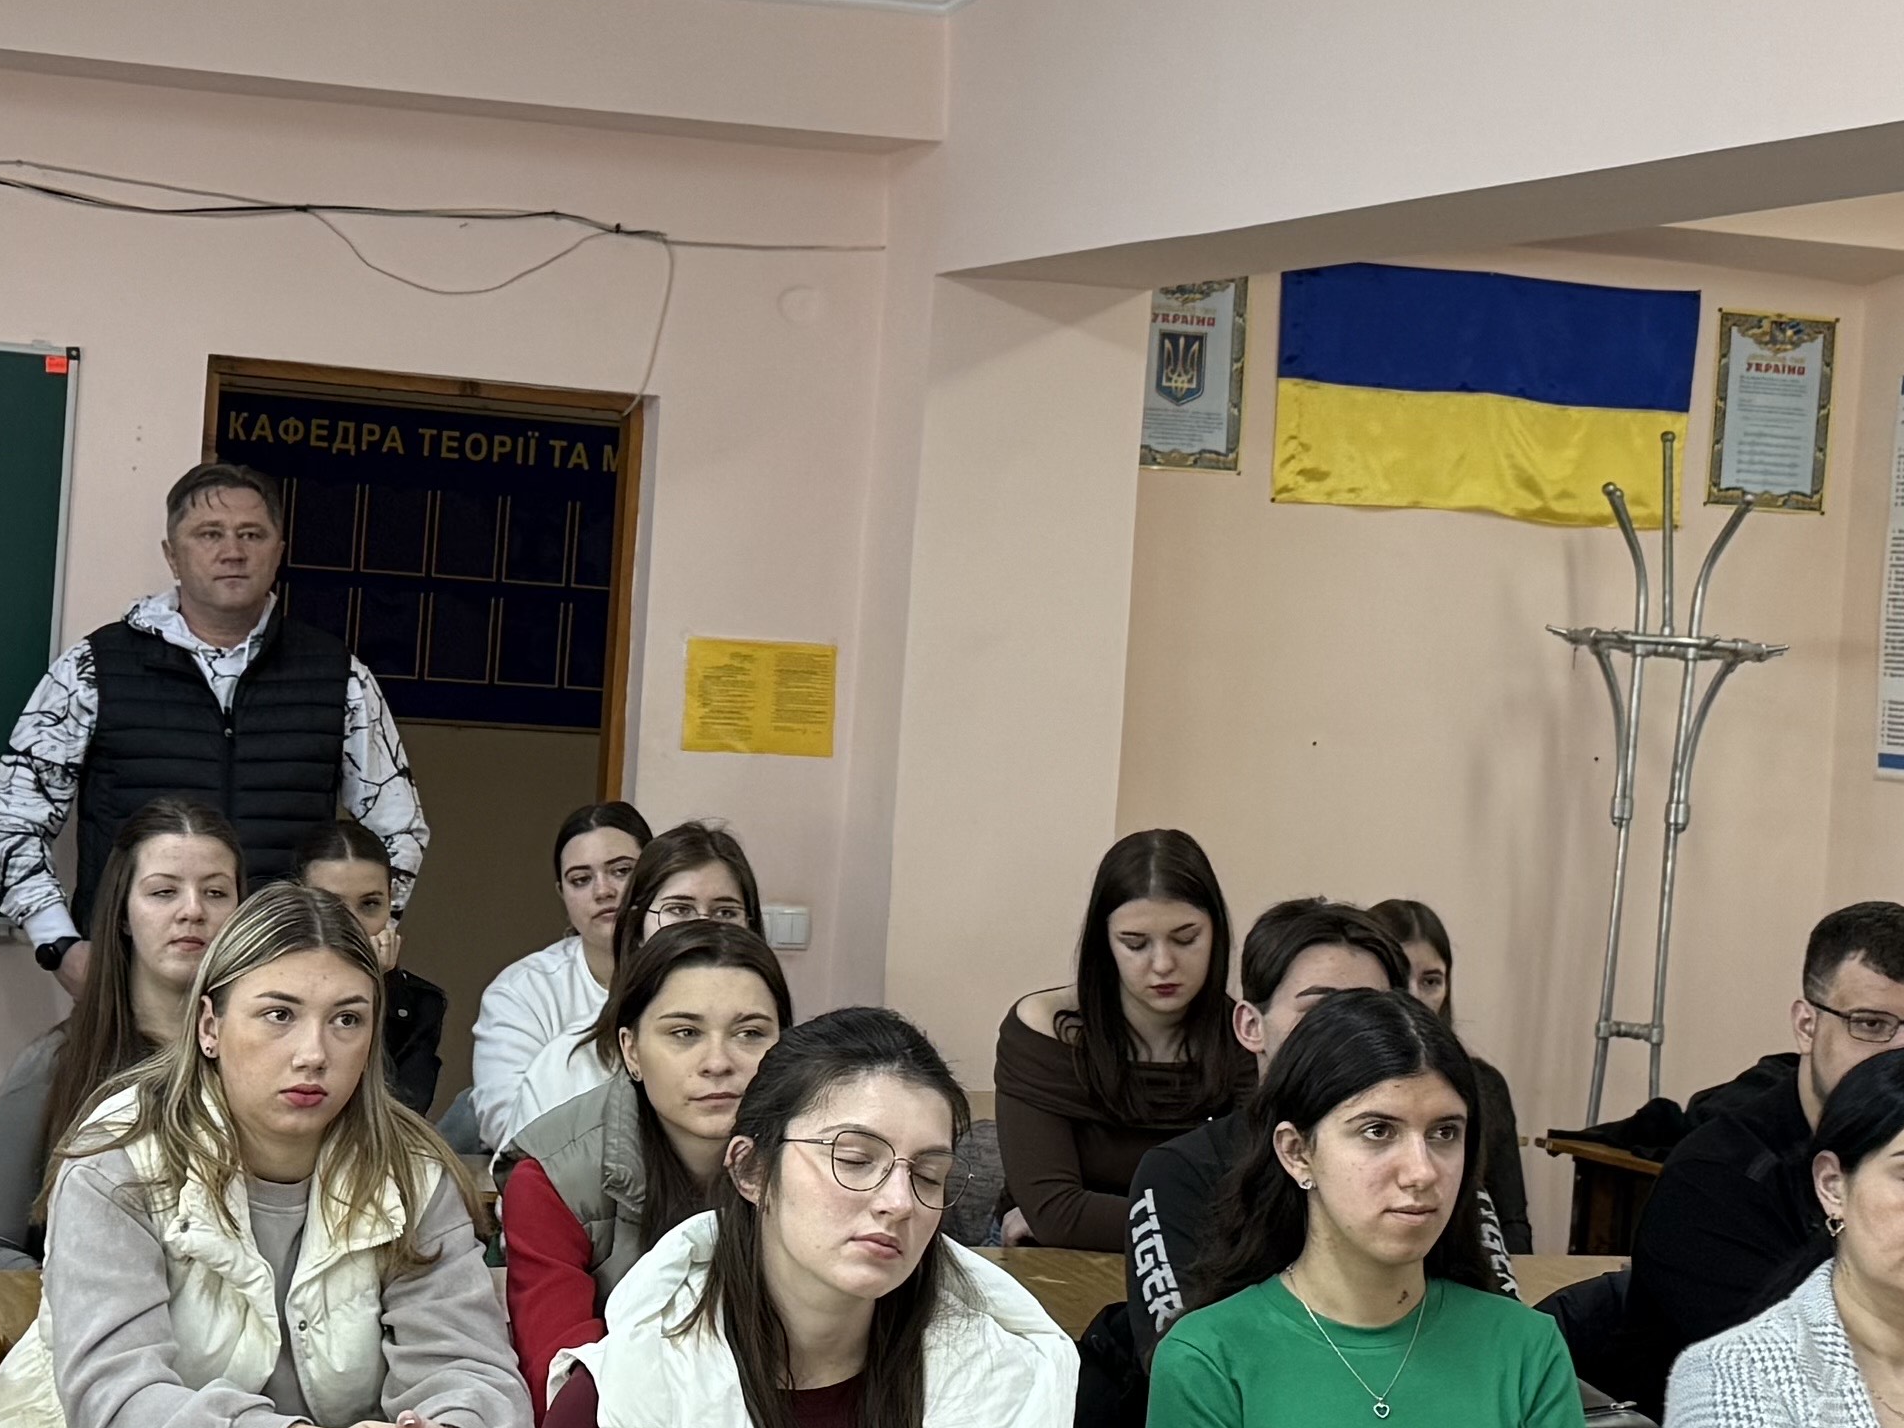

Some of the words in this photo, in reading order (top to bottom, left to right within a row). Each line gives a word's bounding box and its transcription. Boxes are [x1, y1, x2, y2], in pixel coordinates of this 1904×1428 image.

[228, 411, 405, 455] КАФЕДРА
[418, 428, 540, 465] ТЕОРІЇ
[549, 440, 589, 470] ТА
[1129, 1189, 1185, 1332] TIGER
